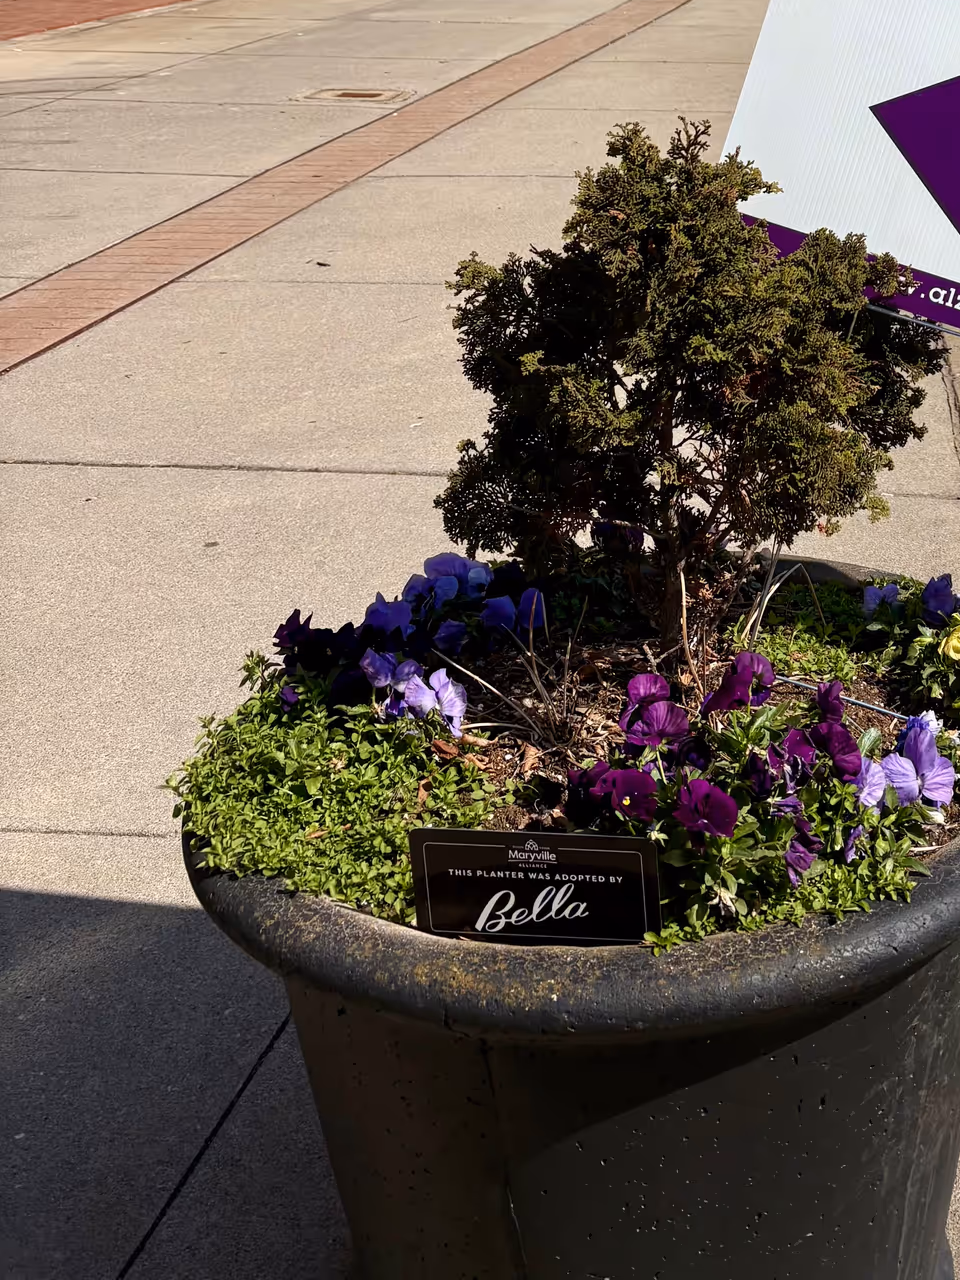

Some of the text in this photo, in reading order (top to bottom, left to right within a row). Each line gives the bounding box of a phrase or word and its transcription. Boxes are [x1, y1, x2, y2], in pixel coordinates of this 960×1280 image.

[508, 849, 556, 862] Maryville
[448, 869, 472, 877] THIS
[476, 870, 525, 879] PLANTER
[528, 872, 551, 880] WAS
[554, 873, 605, 883] ADOPTED
[474, 882, 589, 932] Bella
